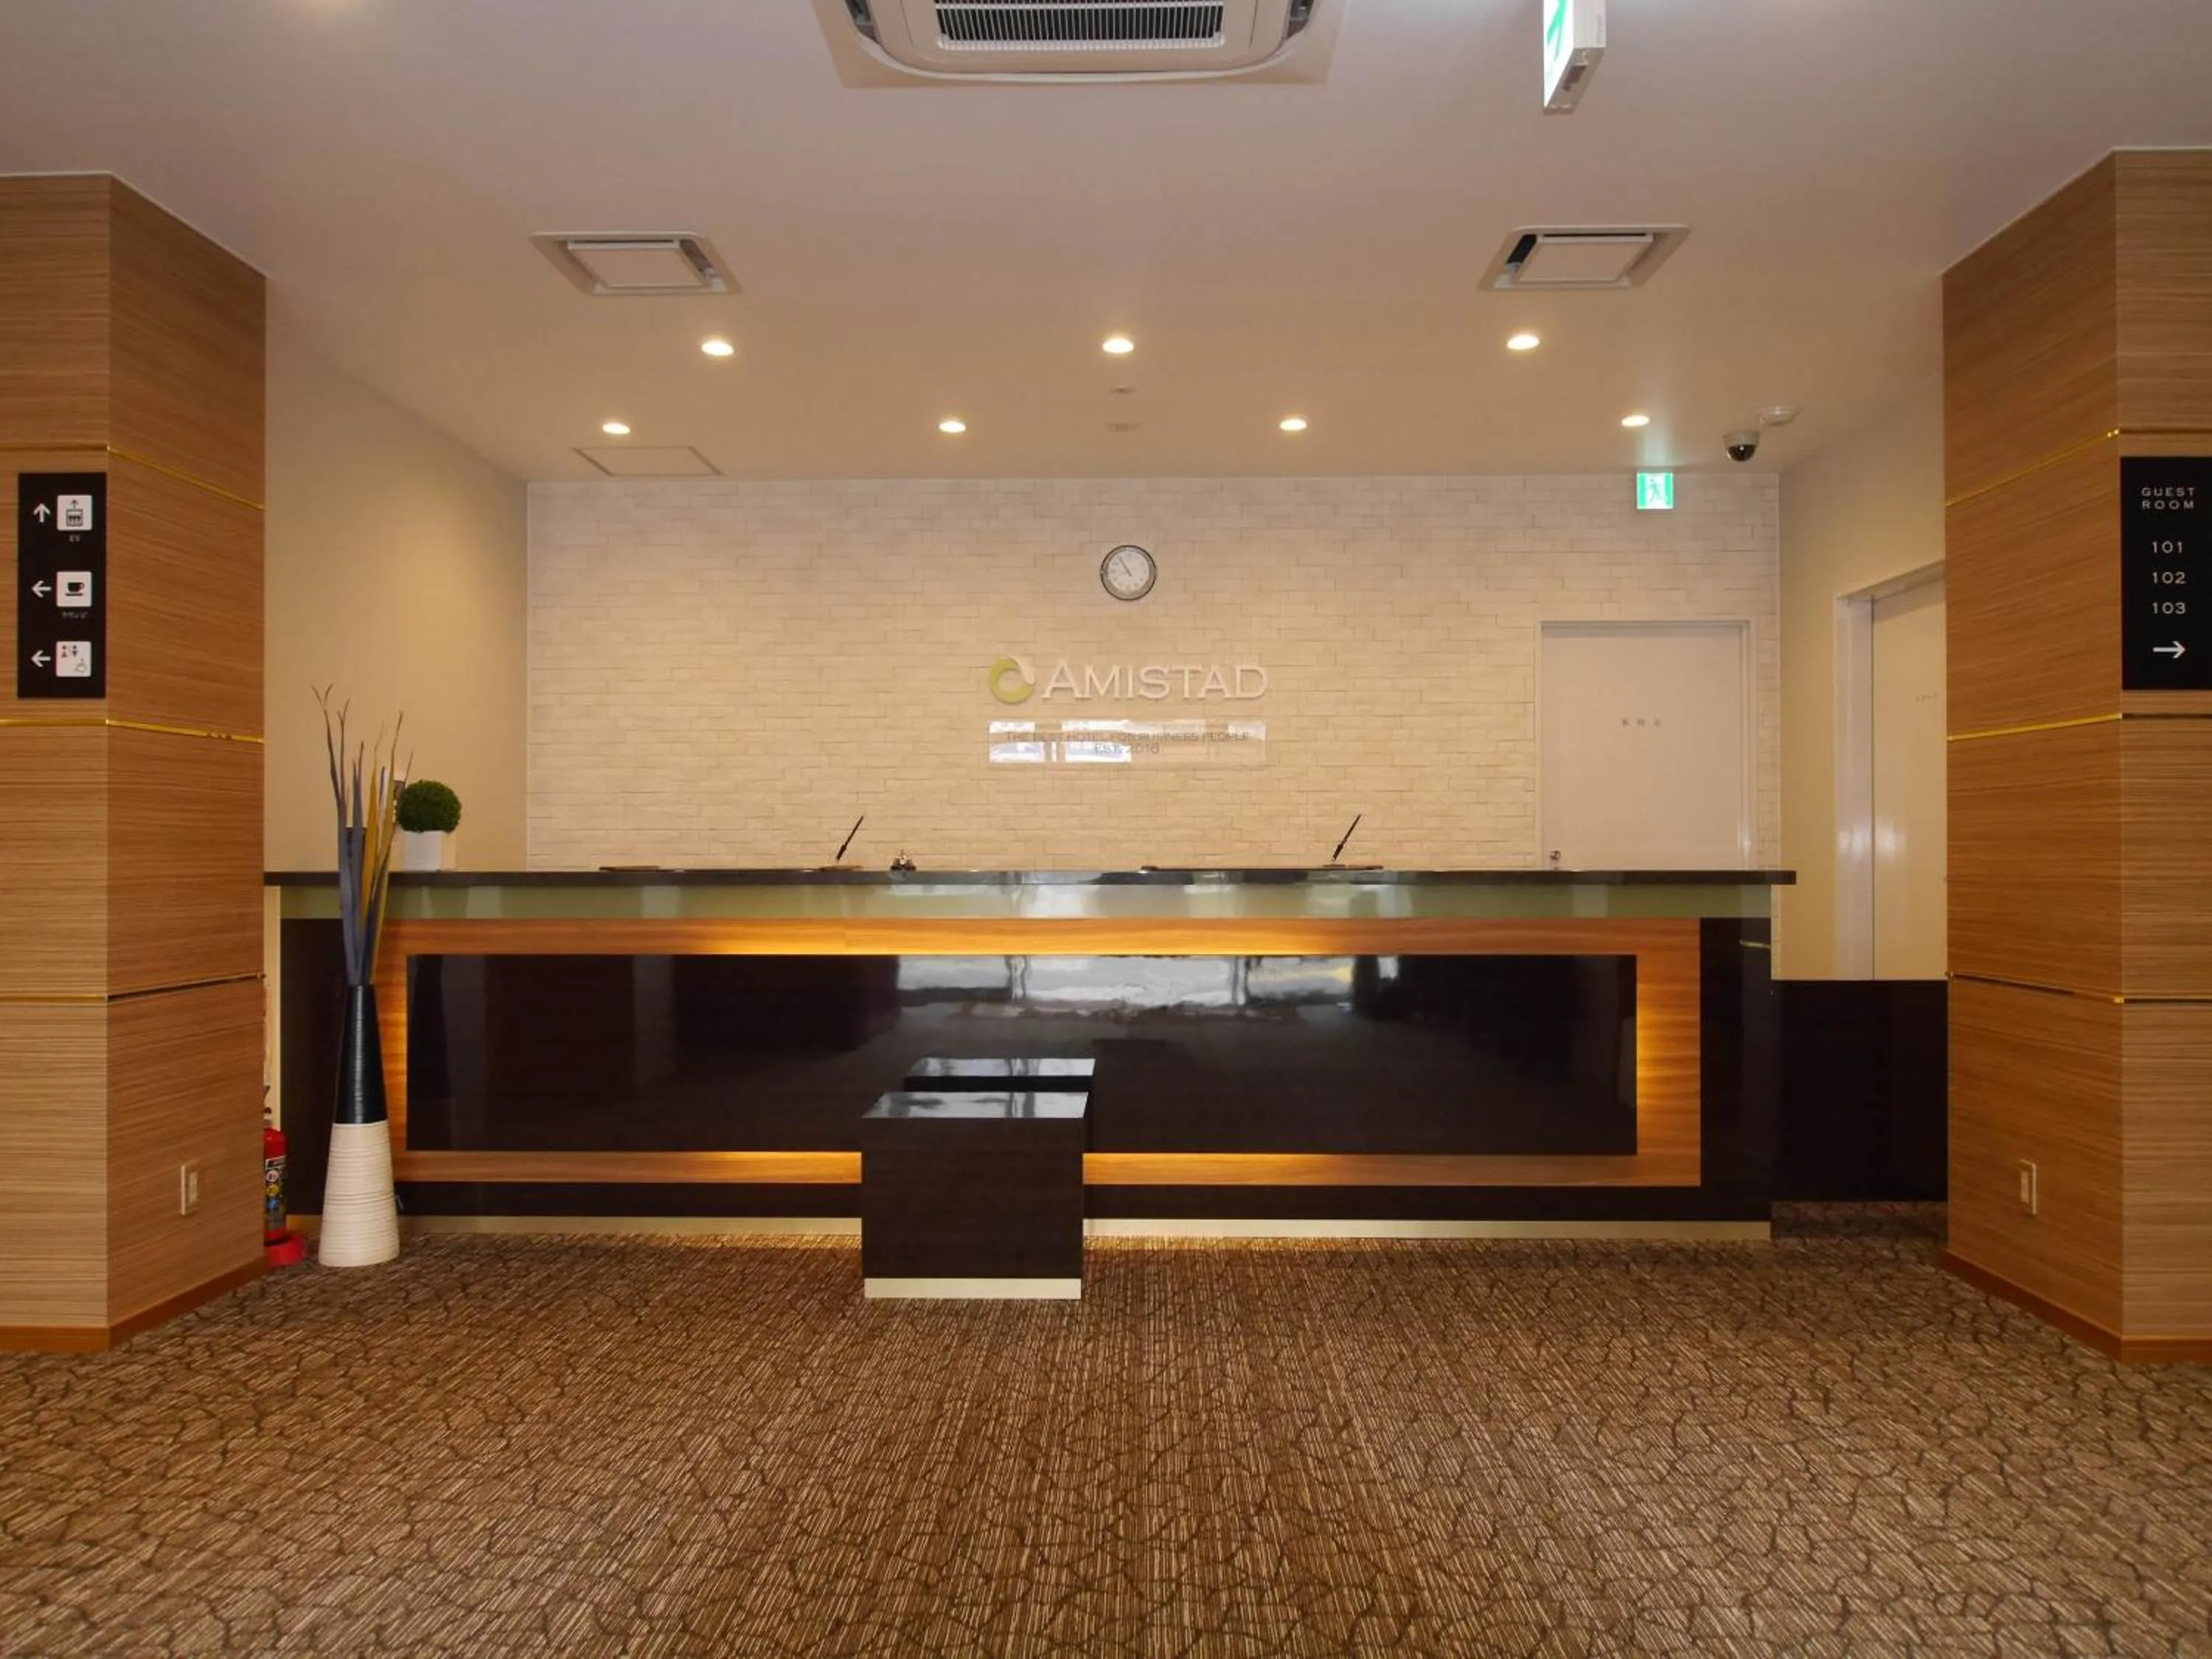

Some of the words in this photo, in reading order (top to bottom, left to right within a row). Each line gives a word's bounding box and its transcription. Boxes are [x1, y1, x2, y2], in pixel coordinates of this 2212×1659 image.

[2140, 487, 2195, 497] GUEST
[2141, 499, 2195, 510] ROOM
[2152, 540, 2183, 554] 101
[2152, 571, 2186, 585] 102
[2152, 601, 2186, 615] 103
[1041, 660, 1268, 700] AMISTAD
[1067, 731, 1105, 742] HOTEL
